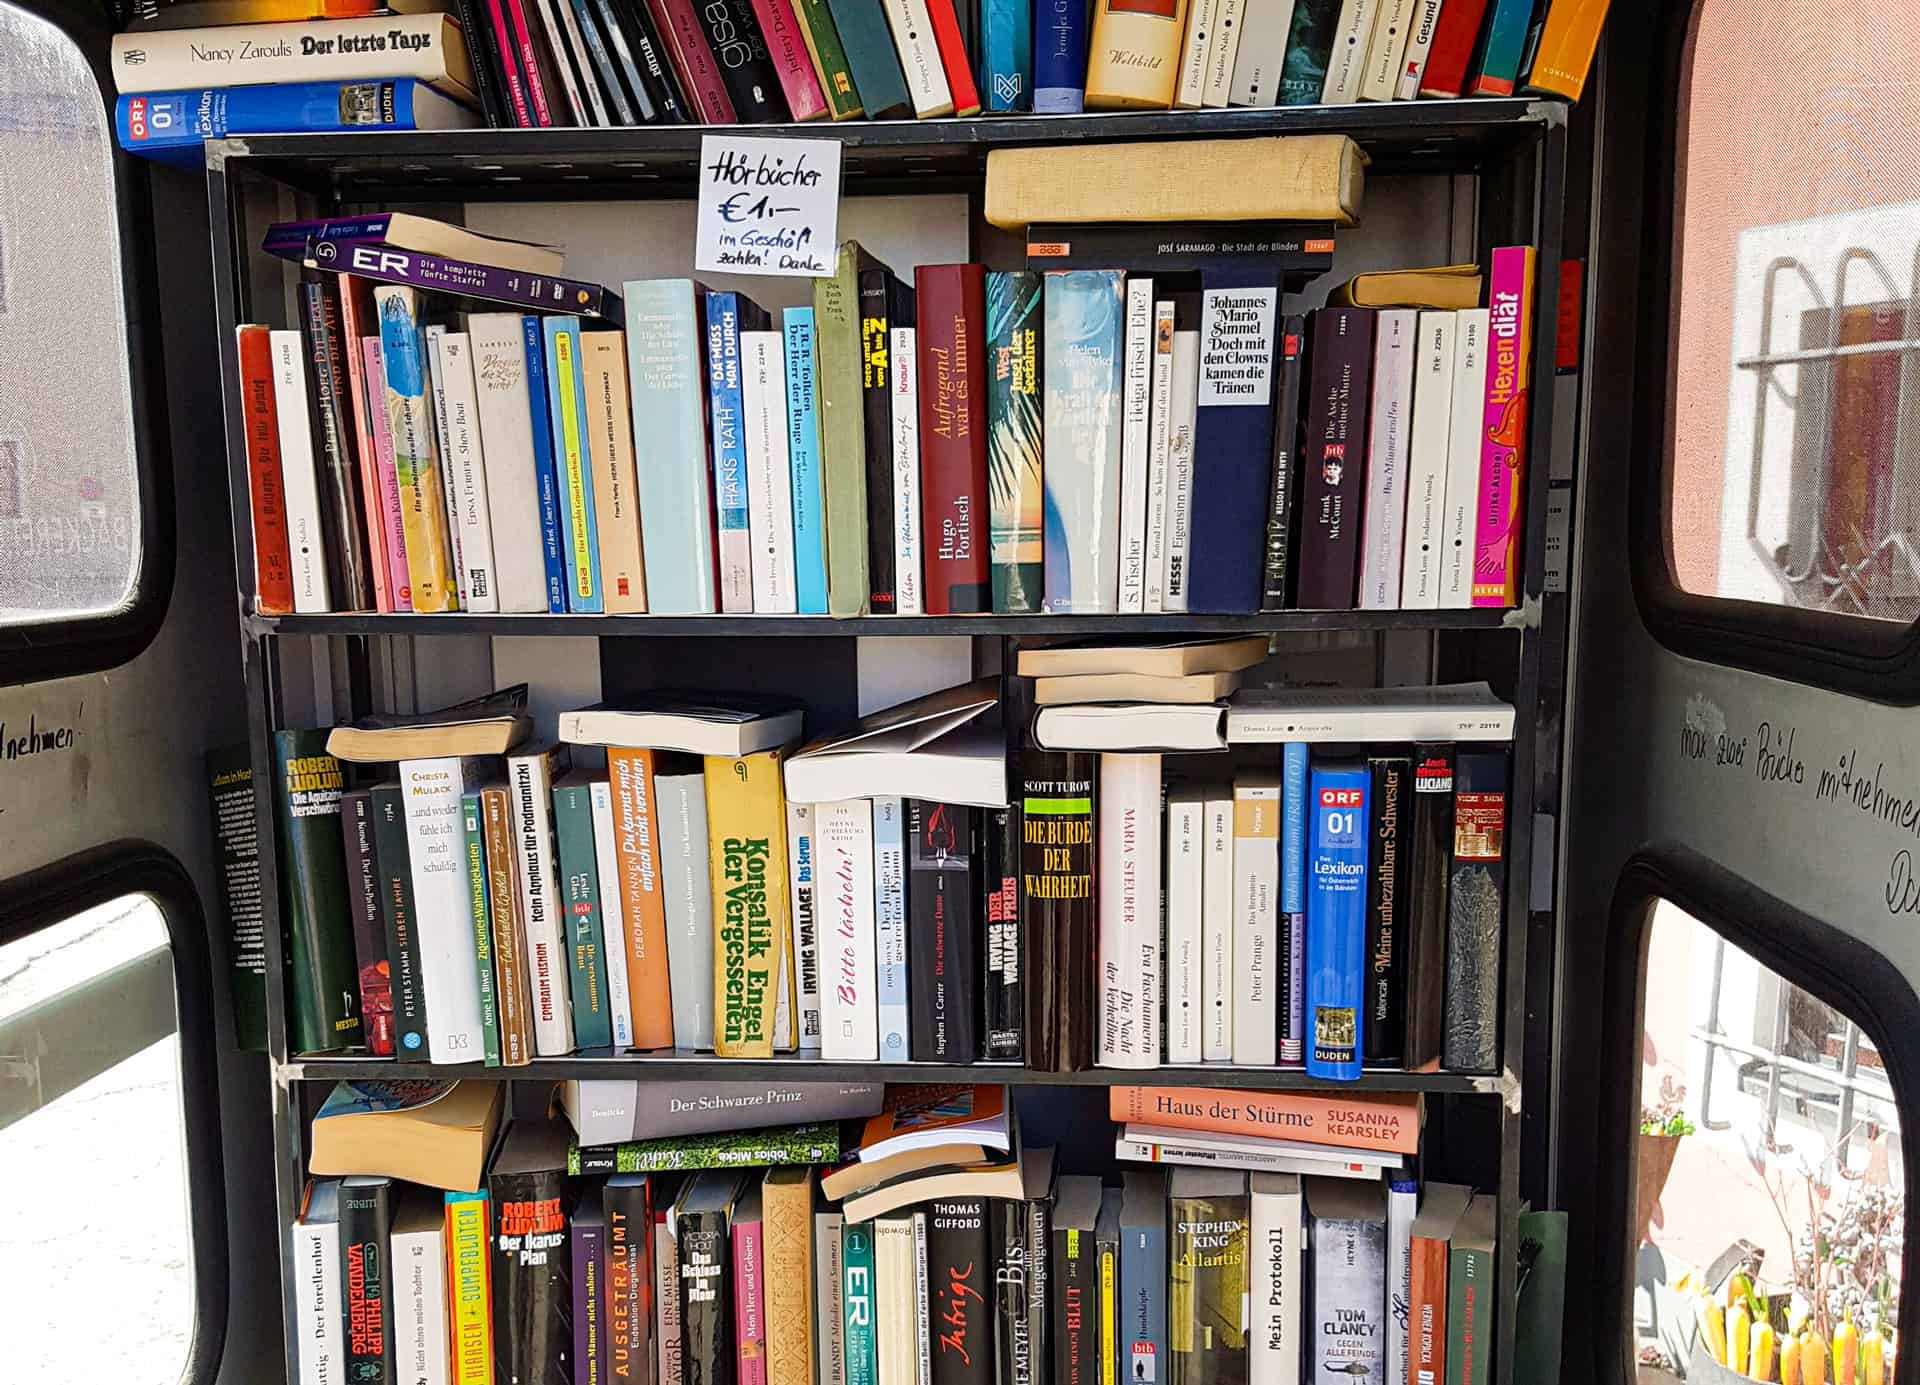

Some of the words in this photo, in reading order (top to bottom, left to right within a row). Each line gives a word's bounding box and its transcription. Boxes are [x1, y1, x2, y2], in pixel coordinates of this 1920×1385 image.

[191, 44, 234, 62] Nancy
[240, 41, 291, 60] Zaroulis
[301, 36, 332, 56] Der
[338, 35, 385, 53] letzte
[389, 30, 431, 51] Tanz
[133, 100, 145, 136] ORF
[151, 103, 171, 128] 01
[201, 91, 213, 138] Lexikon
[384, 87, 394, 124] DUDEN
[708, 152, 821, 186] Hörbücher
[719, 228, 735, 245] im
[1222, 243, 1234, 253] Die
[1235, 243, 1254, 253] Stadt
[1256, 243, 1269, 253] der
[1271, 242, 1299, 252] Blinden
[353, 248, 408, 276] ER
[780, 254, 825, 270] Danke
[1210, 296, 1267, 310] Johannes
[1216, 309, 1258, 322] Mario
[723, 312, 736, 357] DURCH
[789, 325, 799, 347] Der
[869, 318, 886, 334] Z
[1211, 322, 1261, 337] Simmel
[711, 325, 723, 358] MUSS
[875, 333, 884, 349] bis
[952, 315, 968, 374] immer
[1012, 331, 1021, 356] der
[1207, 337, 1242, 351] Doch
[1245, 338, 1265, 351] mit
[712, 360, 725, 380] DA
[791, 350, 800, 379] Herr
[872, 349, 887, 368] A
[1204, 352, 1224, 365] den
[1226, 352, 1269, 365] Clowns
[725, 359, 737, 389] MAN
[876, 367, 885, 387] von
[898, 363, 909, 393] Knaur
[1009, 357, 1024, 392] Insel
[1206, 367, 1246, 380] kamen
[1247, 367, 1264, 379] die
[1341, 363, 1351, 400] Mutter
[792, 383, 801, 404] der
[930, 347, 955, 439] Aufregend
[955, 380, 968, 399] es
[1213, 380, 1255, 395] Tränen
[1327, 387, 1338, 418] Asche
[720, 408, 736, 448] RATH
[793, 408, 804, 445] Ringe
[954, 404, 969, 438] war
[1325, 421, 1336, 439] Die
[1340, 402, 1350, 439] meiner
[720, 458, 740, 505] HANS
[939, 519, 955, 560] Hugo
[955, 495, 970, 560] Portisch
[1169, 555, 1183, 596] HESSE
[412, 772, 449, 782] CHRISTA
[632, 758, 647, 813] verstehen
[1024, 781, 1054, 792] SCOTT
[1056, 781, 1091, 792] TUROW
[413, 786, 451, 796] MULACK
[1322, 792, 1361, 804] ORF
[419, 824, 439, 836] fühle
[635, 815, 650, 846] nicht
[910, 807, 920, 832] List
[1024, 821, 1045, 843] DIE
[1048, 816, 1092, 844] BÜRDE
[1124, 808, 1136, 854] MARIA
[1327, 813, 1354, 835] 01
[428, 844, 448, 853] mich
[724, 839, 747, 881] der
[798, 836, 811, 864] Serum
[1044, 849, 1070, 871] DER
[423, 861, 457, 872] schuldig
[639, 848, 655, 891] einfach
[798, 866, 812, 882] Das
[1315, 861, 1363, 875] Lexikon
[392, 877, 405, 907] JAHRE
[579, 873, 589, 899] Leslie
[629, 857, 641, 904] TANNEN
[1024, 875, 1091, 898] WAHRHEIT
[1124, 860, 1135, 924] STEURER
[746, 838, 770, 958] Konsalik
[397, 911, 408, 946] SIEBEN
[798, 888, 815, 945] WALLACE
[634, 906, 645, 958] DEBORAH
[721, 884, 747, 1043] Vergessenen
[1251, 935, 1265, 972] Prange
[401, 951, 412, 985] STAMM
[481, 969, 491, 993] Biwer
[800, 950, 817, 994] IRVING
[1106, 962, 1119, 982] der
[403, 987, 415, 1017] PETER
[935, 983, 945, 1010] Carter
[1250, 975, 1263, 1002] Peter
[482, 1005, 493, 1026] Anne
[742, 969, 769, 1042] Engel
[1120, 991, 1133, 1015] Die
[1104, 986, 1119, 1054] Verheißung
[936, 1022, 946, 1055] Stephen
[1120, 1018, 1133, 1054] Nacht
[1315, 1050, 1350, 1060] DUDEN
[670, 1098, 696, 1113] Der
[698, 1096, 763, 1112] Schwarze
[767, 1090, 802, 1104] Prinz
[1157, 1096, 1204, 1117] Haus
[1208, 1106, 1240, 1120] der
[1246, 1104, 1314, 1127] Stürme
[1327, 1110, 1400, 1127] SUSANNA
[1327, 1124, 1400, 1140] KEARSLEY
[719, 1151, 752, 1161] Micke
[754, 1149, 789, 1160] Tobias
[503, 1199, 560, 1219] ROBERT
[934, 1204, 980, 1214] THOMAS
[934, 1218, 980, 1229] GIFFORD
[1178, 1222, 1242, 1235] STEPHEN
[744, 1236, 753, 1271] Gebieter
[1192, 1236, 1229, 1248] KING
[519, 1250, 547, 1267] Plan
[629, 1244, 638, 1299] Drogenknast
[1269, 1227, 1282, 1306] Protokoll
[311, 1236, 323, 1311] Forellenhof
[663, 1264, 672, 1297] MESSE
[349, 1244, 366, 1354] VANDENBERG
[612, 1211, 629, 1377] AUSGETRÄUMT
[745, 1292, 755, 1312] Herr
[848, 1266, 869, 1327] ER
[314, 1315, 326, 1338] Der
[367, 1298, 383, 1355] PHILIPP
[630, 1302, 639, 1348] Endstation
[746, 1314, 756, 1336] Mein
[1335, 1309, 1366, 1322] TOM
[1268, 1315, 1281, 1350] Mein
[1324, 1322, 1376, 1337] CLANCY
